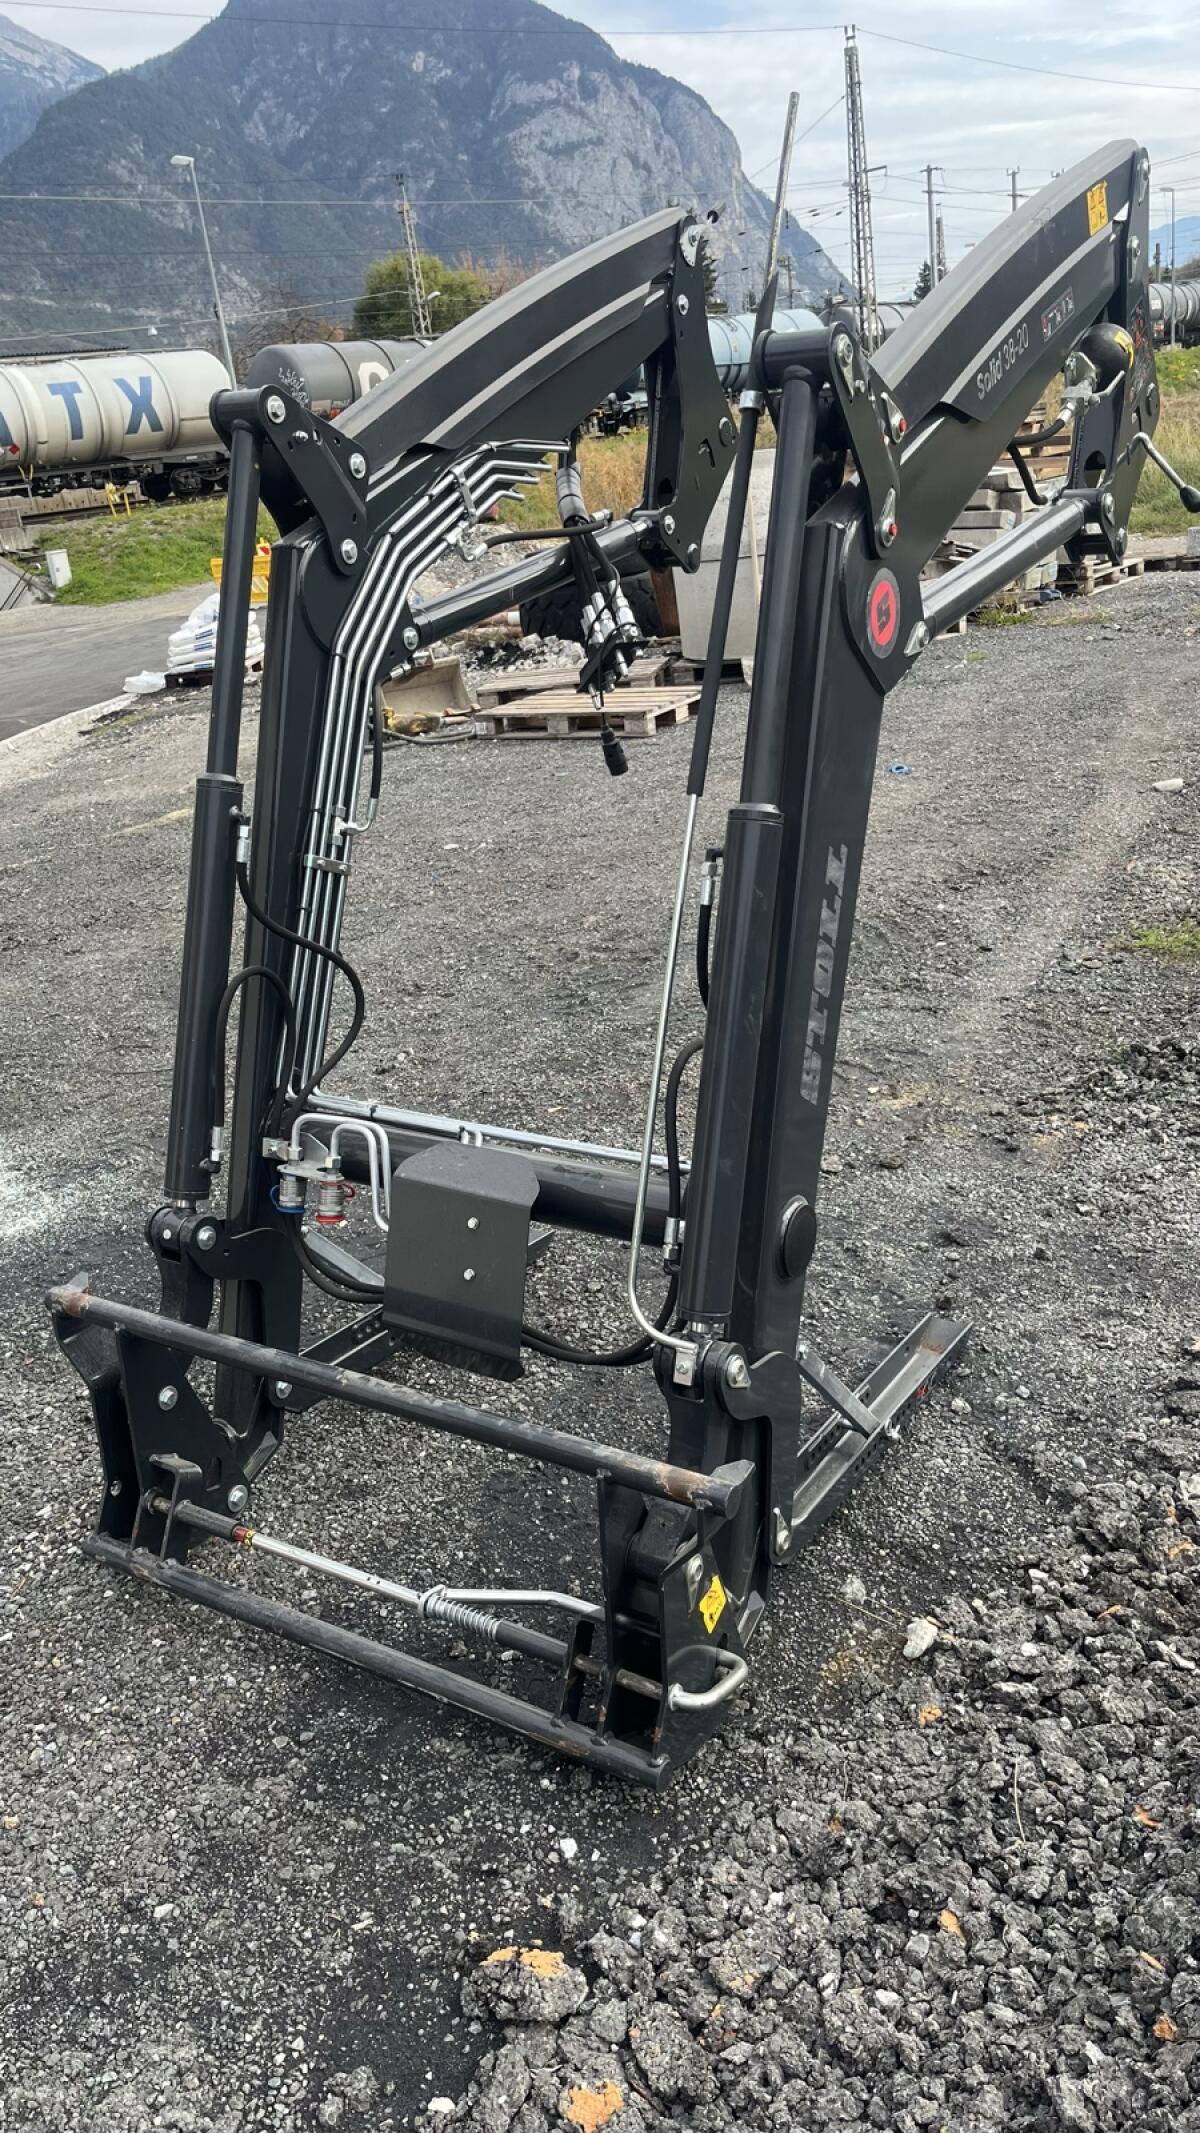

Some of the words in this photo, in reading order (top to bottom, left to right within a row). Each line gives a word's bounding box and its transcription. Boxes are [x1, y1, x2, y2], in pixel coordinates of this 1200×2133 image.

[977, 351, 1003, 400] Solid
[1003, 322, 1029, 370] 38-20
[799, 843, 848, 1105] STOLL
